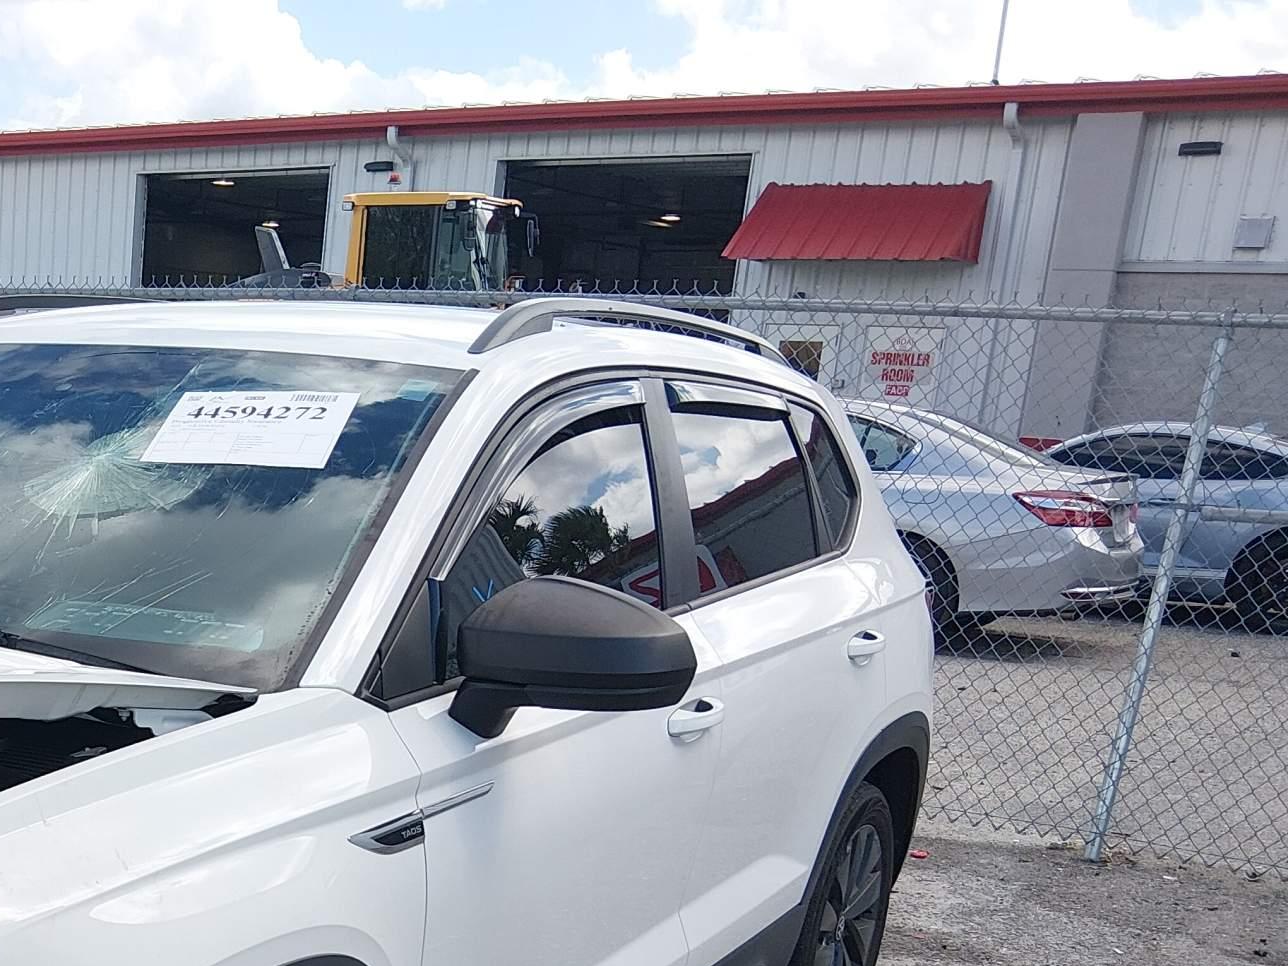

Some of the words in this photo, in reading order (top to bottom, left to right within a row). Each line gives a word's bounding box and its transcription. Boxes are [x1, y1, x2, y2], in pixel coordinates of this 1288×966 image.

[871, 351, 931, 367] SPRINKLER
[881, 368, 915, 383] ROOM
[187, 405, 328, 420] 44594272
[400, 824, 422, 839] TAOS
